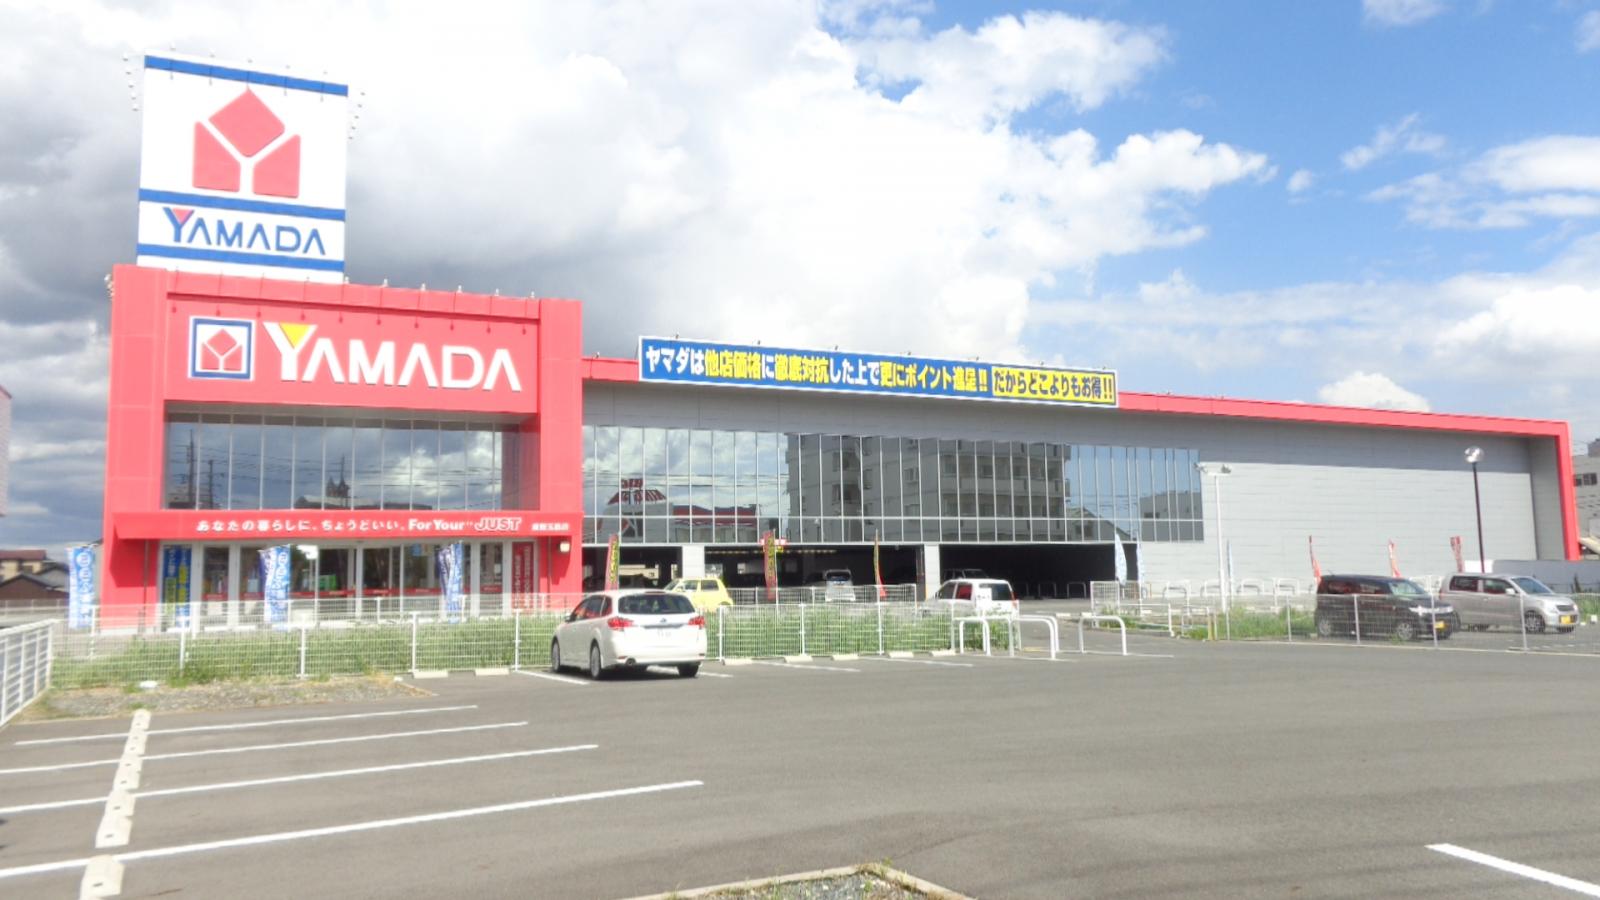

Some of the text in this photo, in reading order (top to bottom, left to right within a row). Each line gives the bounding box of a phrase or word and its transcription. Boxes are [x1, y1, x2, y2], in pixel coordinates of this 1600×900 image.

[164, 207, 326, 255] YAMADA
[263, 321, 522, 393] YAMADA
[475, 517, 522, 532] JUST
